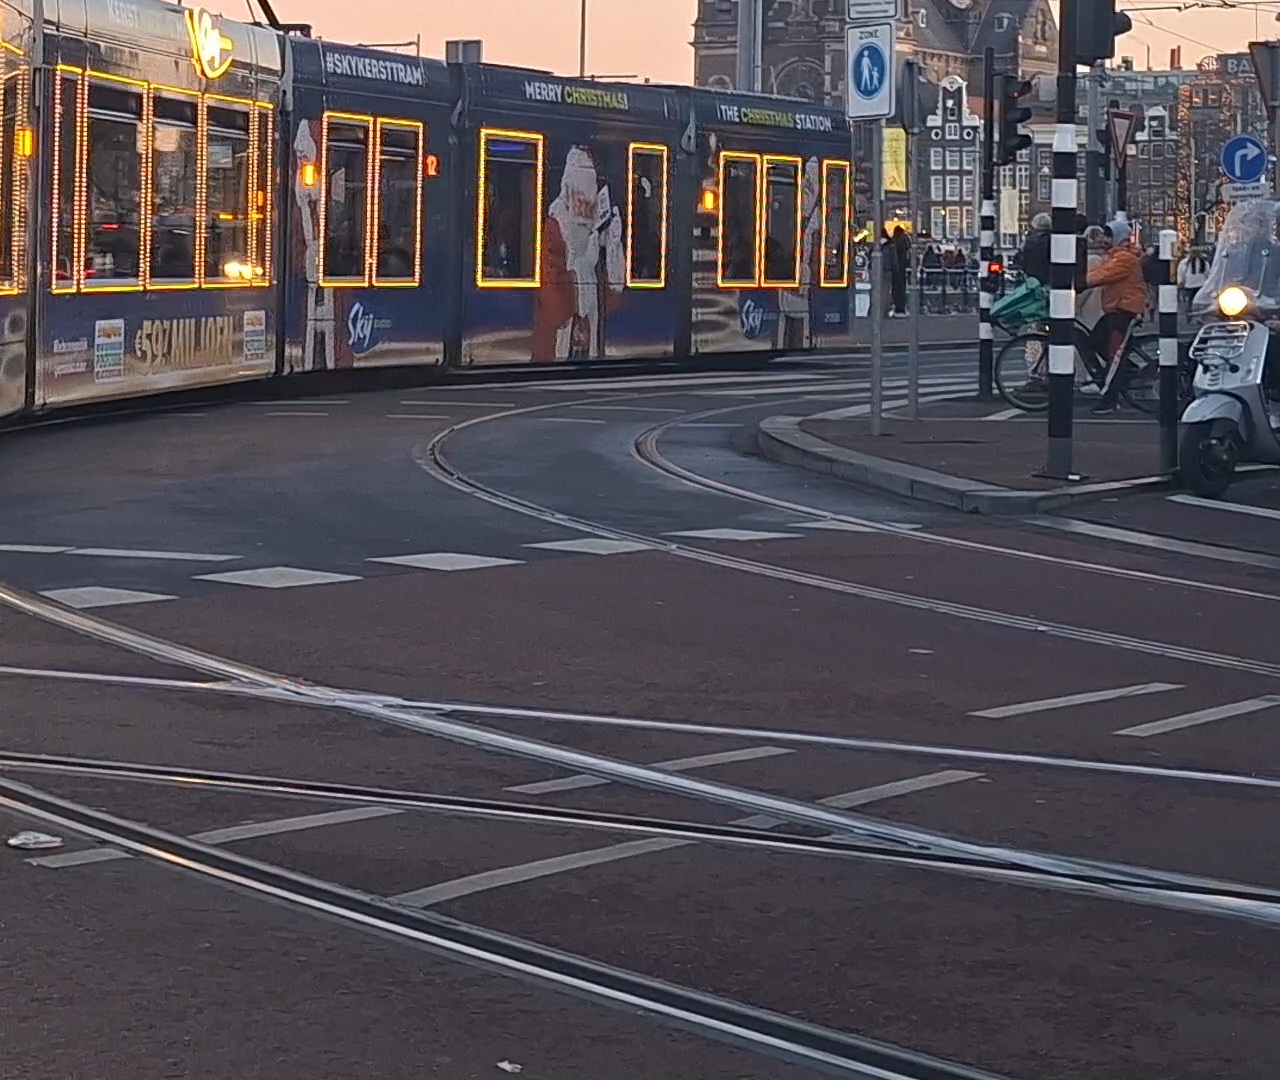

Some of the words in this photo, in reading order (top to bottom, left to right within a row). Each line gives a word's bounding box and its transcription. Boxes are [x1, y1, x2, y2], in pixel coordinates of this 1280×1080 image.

[524, 81, 562, 102] MERRY
[721, 105, 740, 122] THE
[741, 107, 795, 128] CHRISTMAS
[795, 114, 833, 131] STATION
